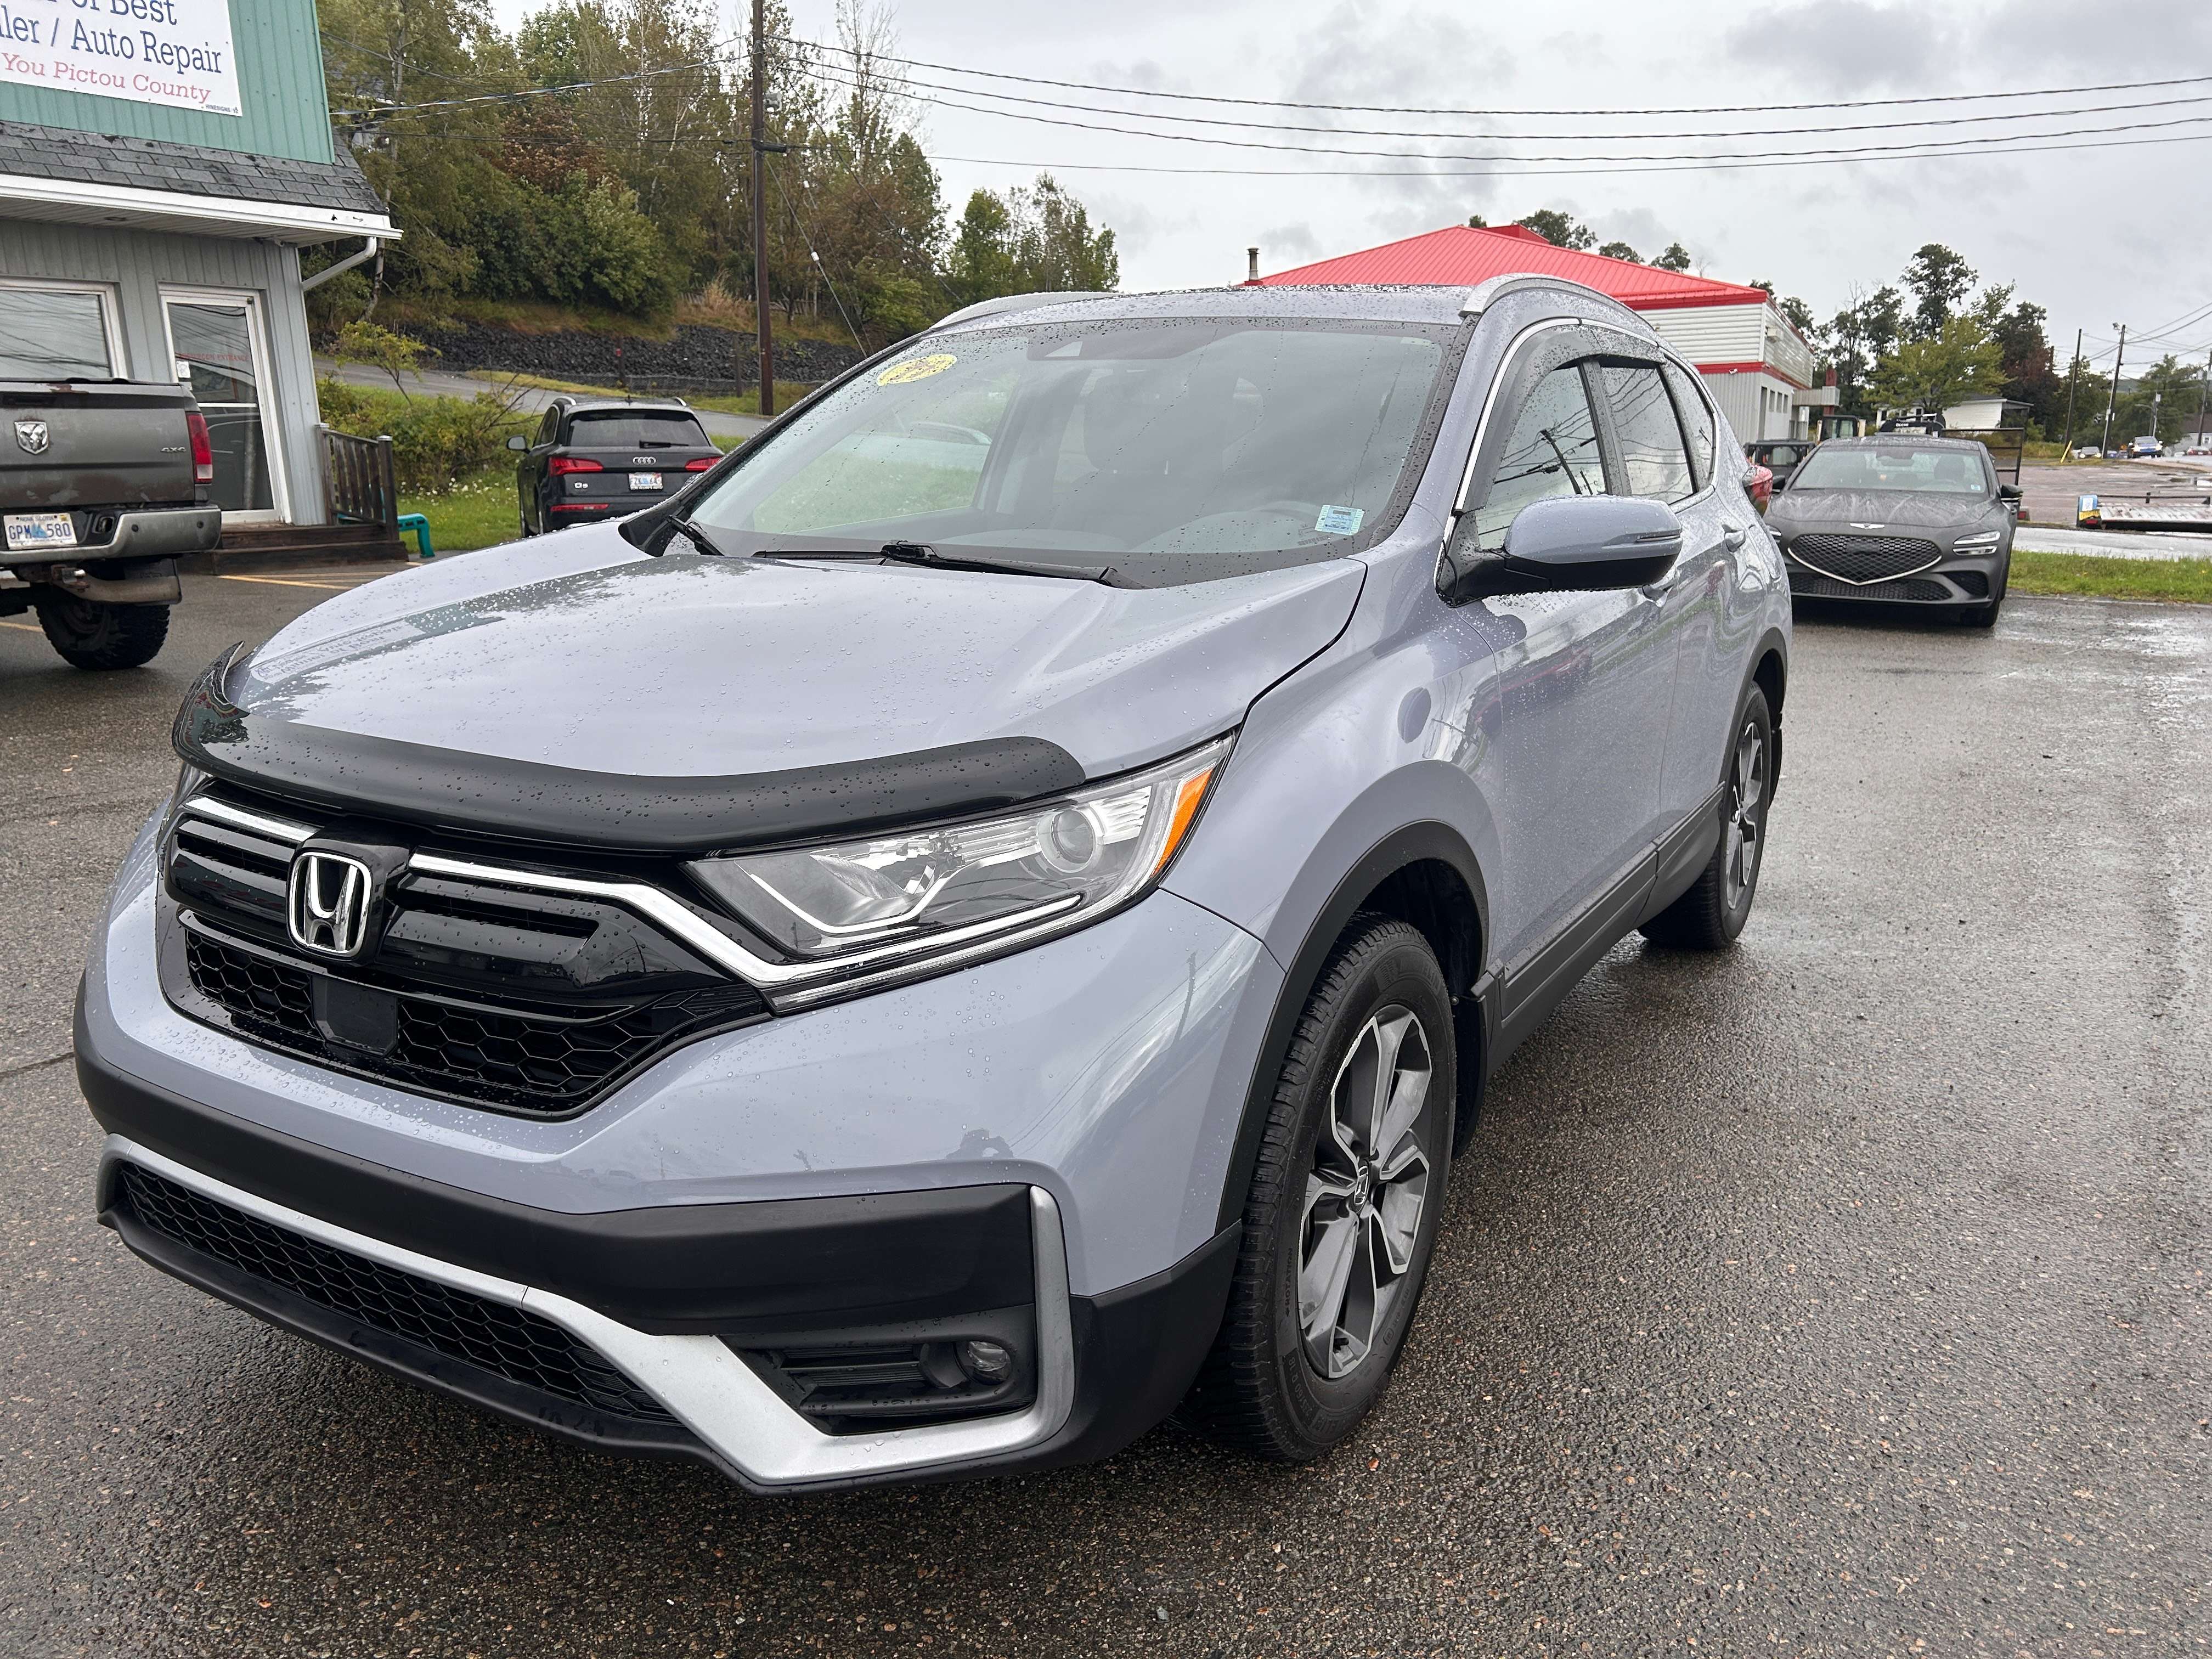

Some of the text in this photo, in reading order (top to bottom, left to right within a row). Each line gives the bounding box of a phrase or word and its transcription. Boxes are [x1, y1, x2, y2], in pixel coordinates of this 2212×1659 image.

[0, 4, 40, 44] ler
[71, 19, 134, 59] Auto
[140, 30, 222, 75] Repair
[2, 53, 211, 104] You Pictou County
[9, 523, 71, 540] GPM 580
